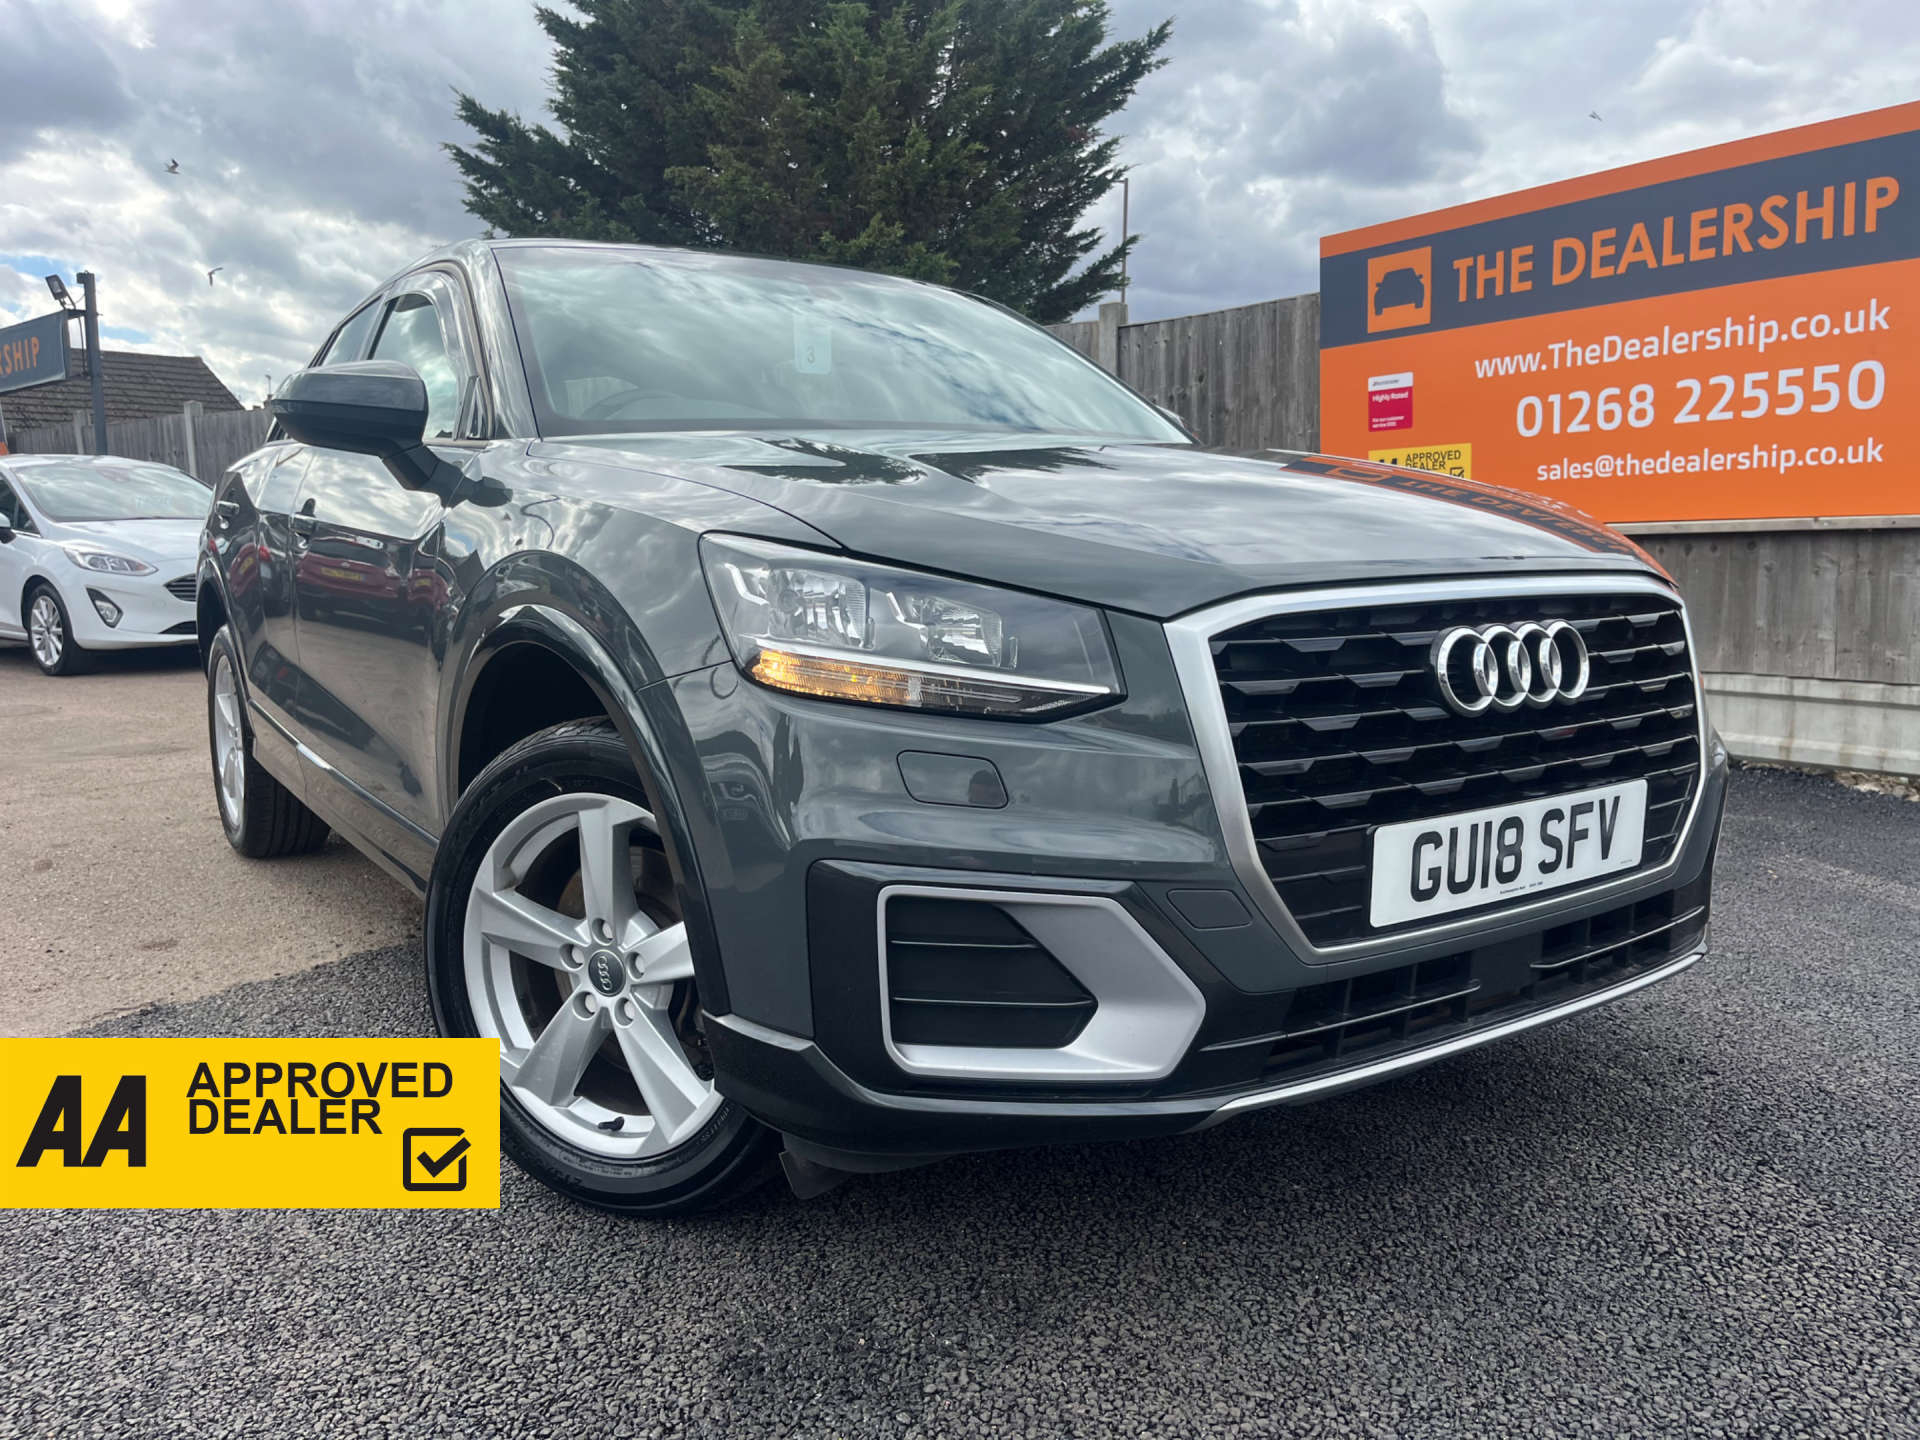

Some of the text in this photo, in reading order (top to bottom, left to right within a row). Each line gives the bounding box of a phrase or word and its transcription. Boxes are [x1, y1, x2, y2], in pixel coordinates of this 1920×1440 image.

[1453, 176, 1900, 303] THE DEALERSHIP
[0, 336, 40, 377] SHIP
[1475, 298, 1891, 379] www.TheDealership.co.uk
[1516, 360, 1886, 438] 01268 225550
[1405, 449, 1461, 463] APPROVED
[1536, 437, 1884, 482] sales@thedealership.co.uk
[1411, 795, 1621, 903] GU18 SFV
